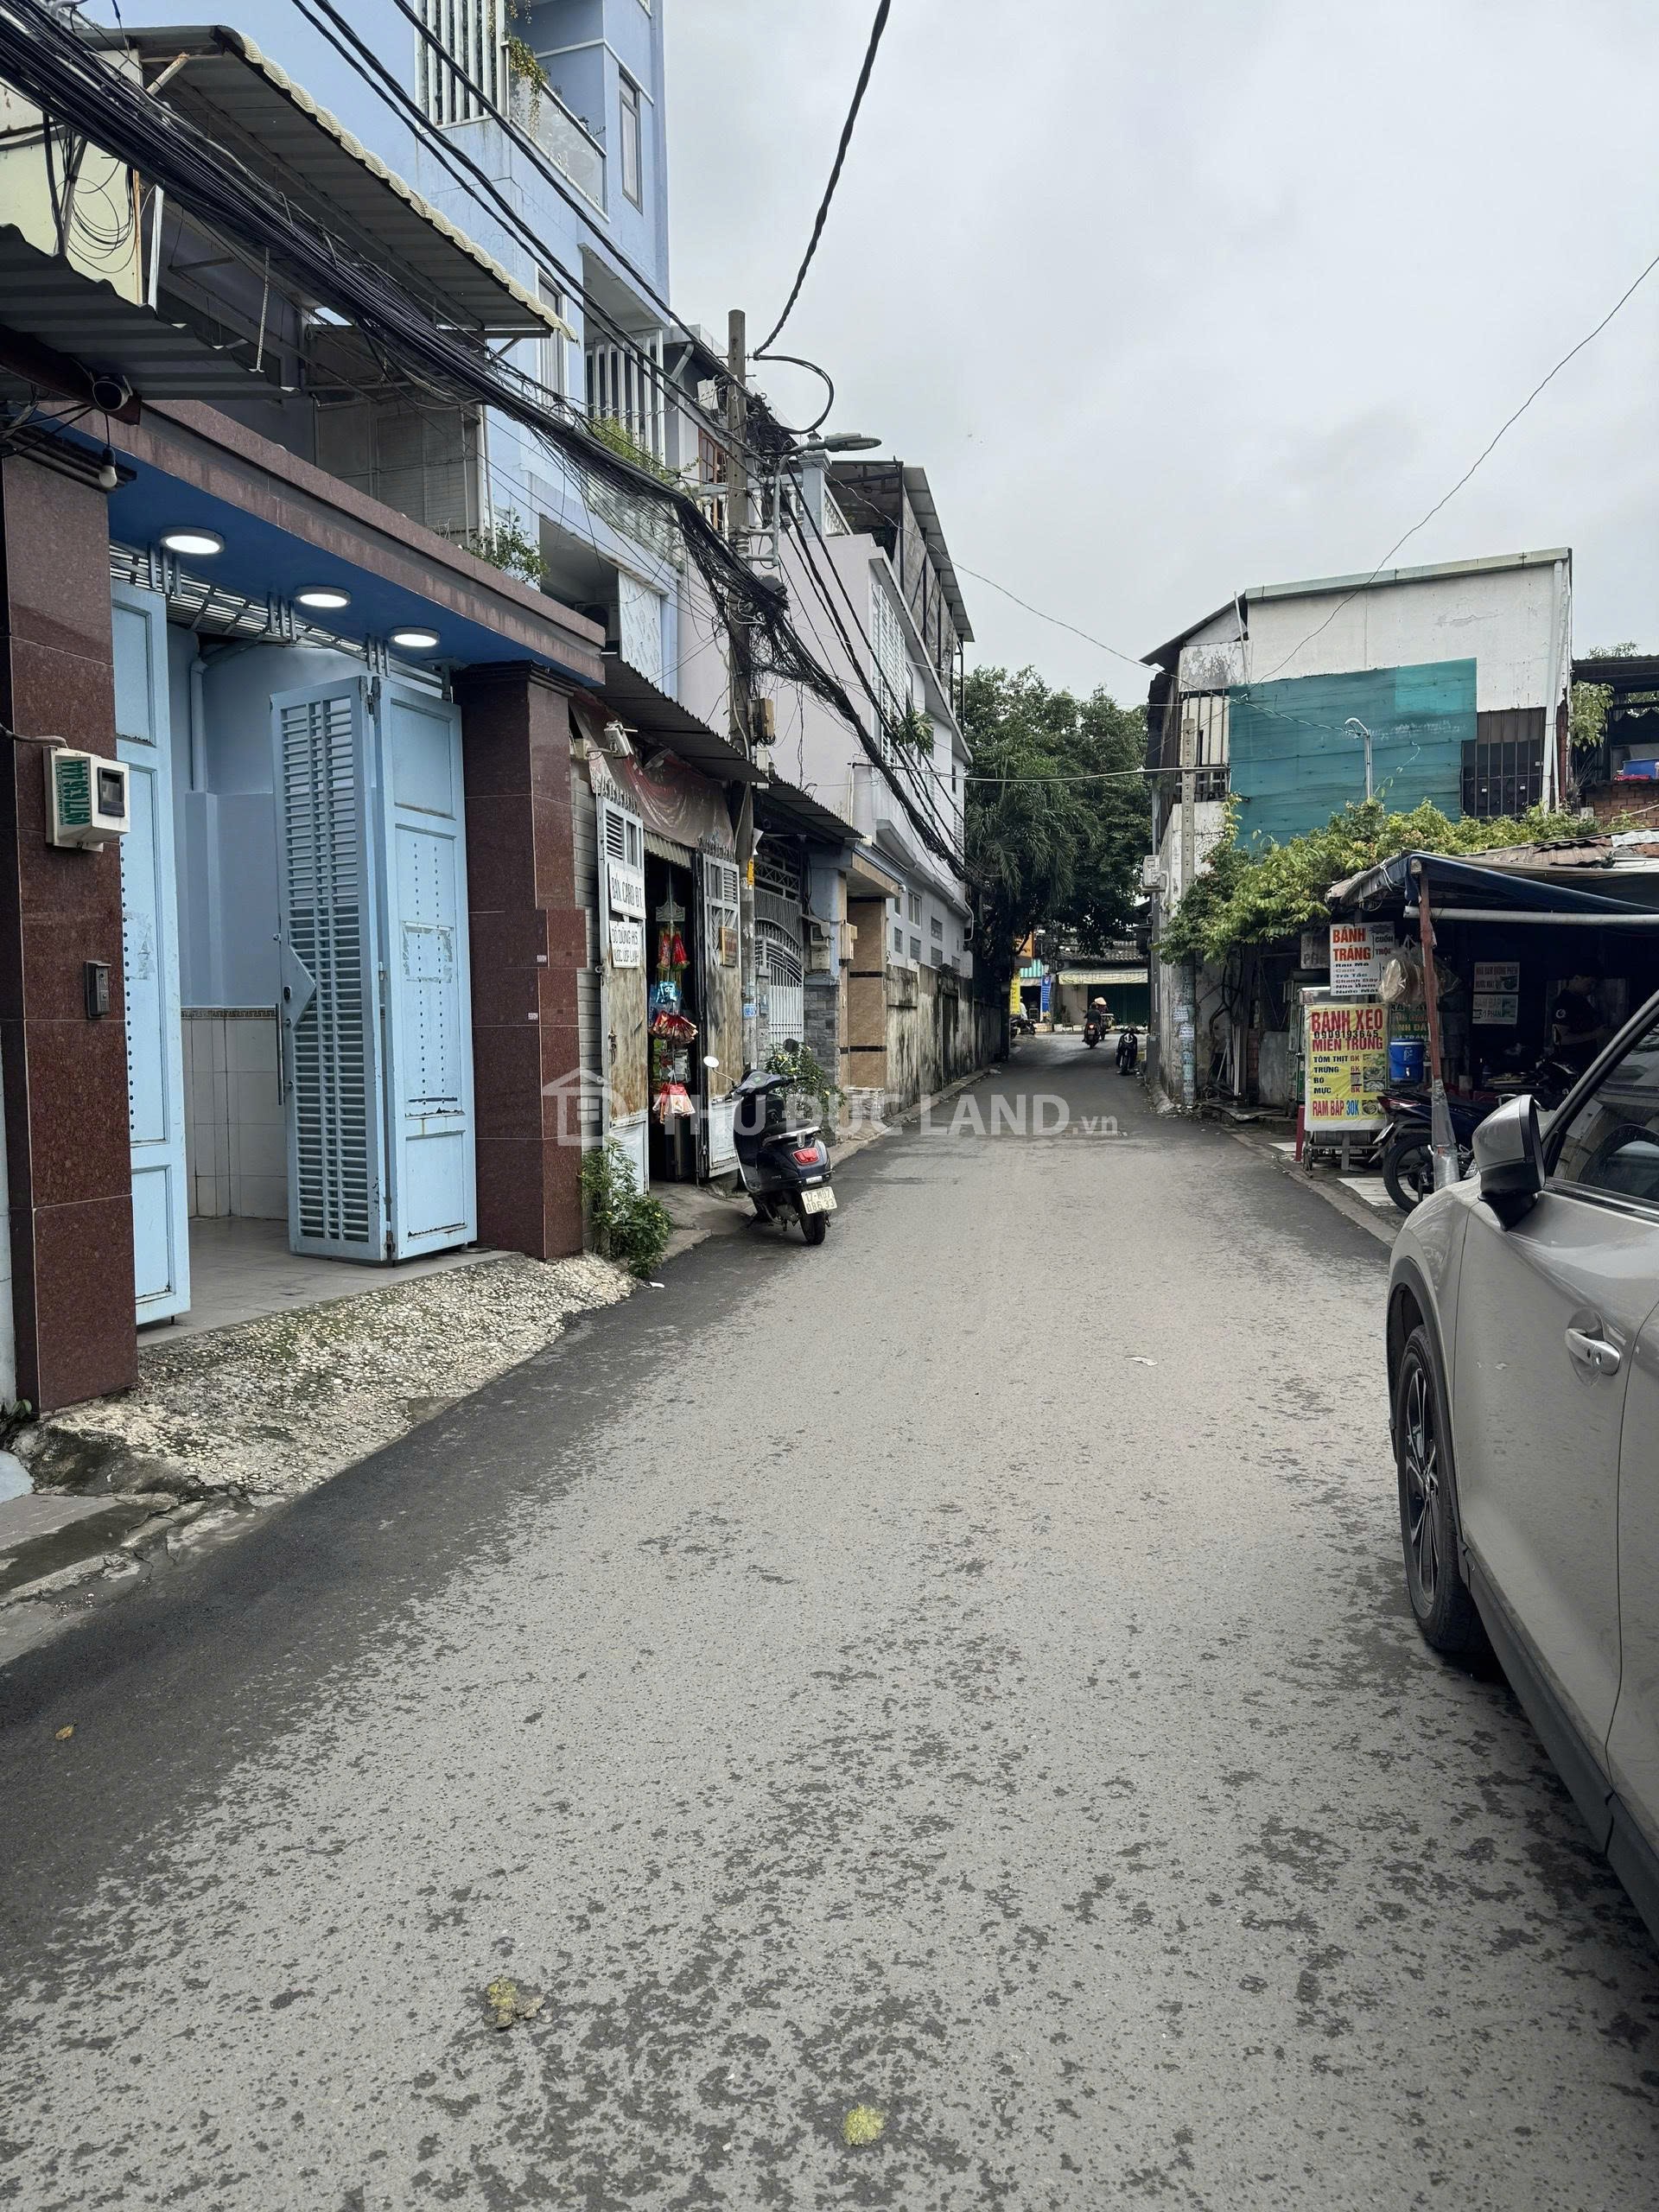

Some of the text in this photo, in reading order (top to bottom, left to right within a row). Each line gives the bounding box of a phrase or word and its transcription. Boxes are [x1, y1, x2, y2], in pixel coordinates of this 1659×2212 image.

[61, 760, 91, 825] 0977.636.444
[1332, 925, 1366, 944] BÁNH
[1332, 945, 1371, 962] TRÁNG
[1376, 947, 1391, 957] TRỘ
[1311, 1007, 1351, 1033] BÁNH
[1313, 1029, 1379, 1039] 0909193645
[1345, 1037, 1383, 1051] TRUNG
[1313, 1099, 1328, 1116] RAM
[1345, 1099, 1359, 1116] 30K
